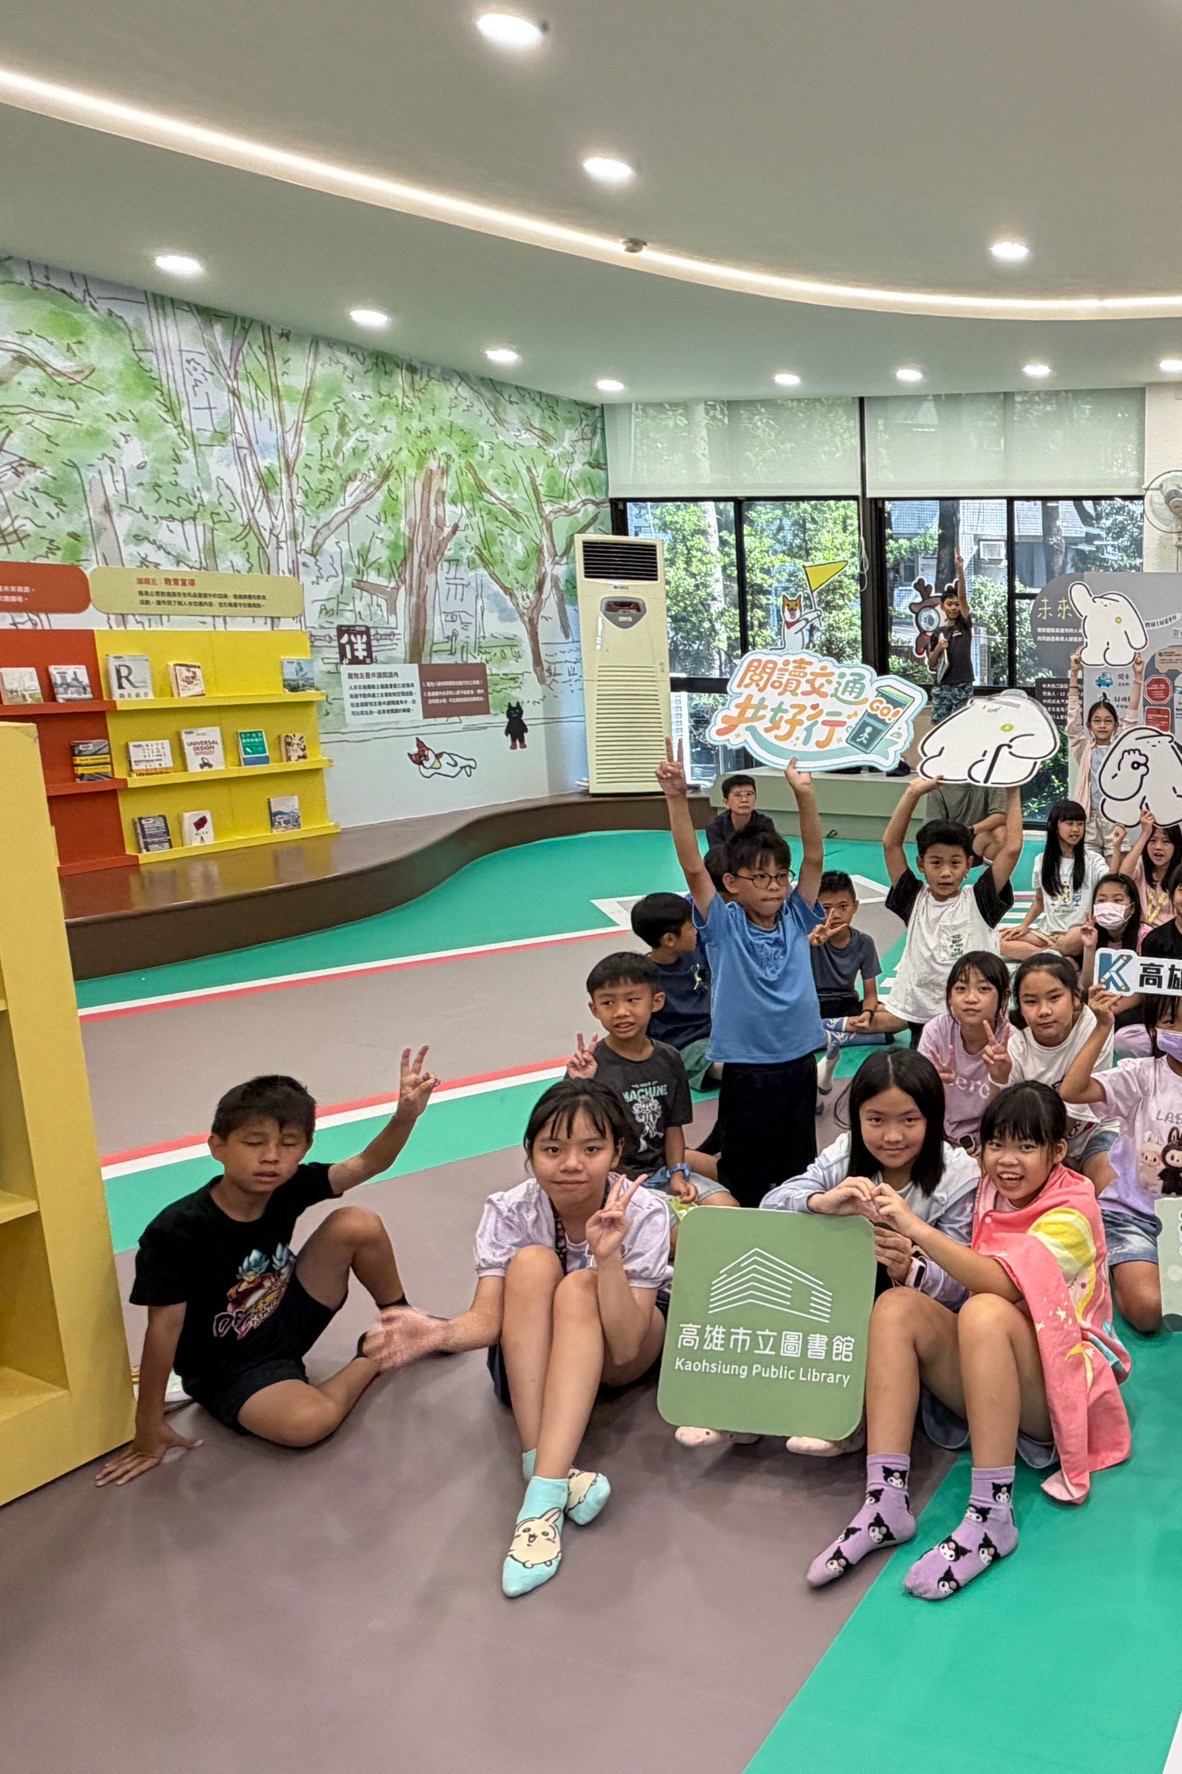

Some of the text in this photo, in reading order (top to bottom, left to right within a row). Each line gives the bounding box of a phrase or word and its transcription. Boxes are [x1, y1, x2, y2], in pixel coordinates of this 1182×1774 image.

[340, 633, 367, 660] 伴
[736, 658, 879, 705] 閱讀交通
[715, 694, 847, 749] 共好行
[869, 698, 901, 722] GO!
[677, 1322, 856, 1363] 高雄市立圖書館
[675, 1357, 850, 1388] Kaohsiung Public Library
